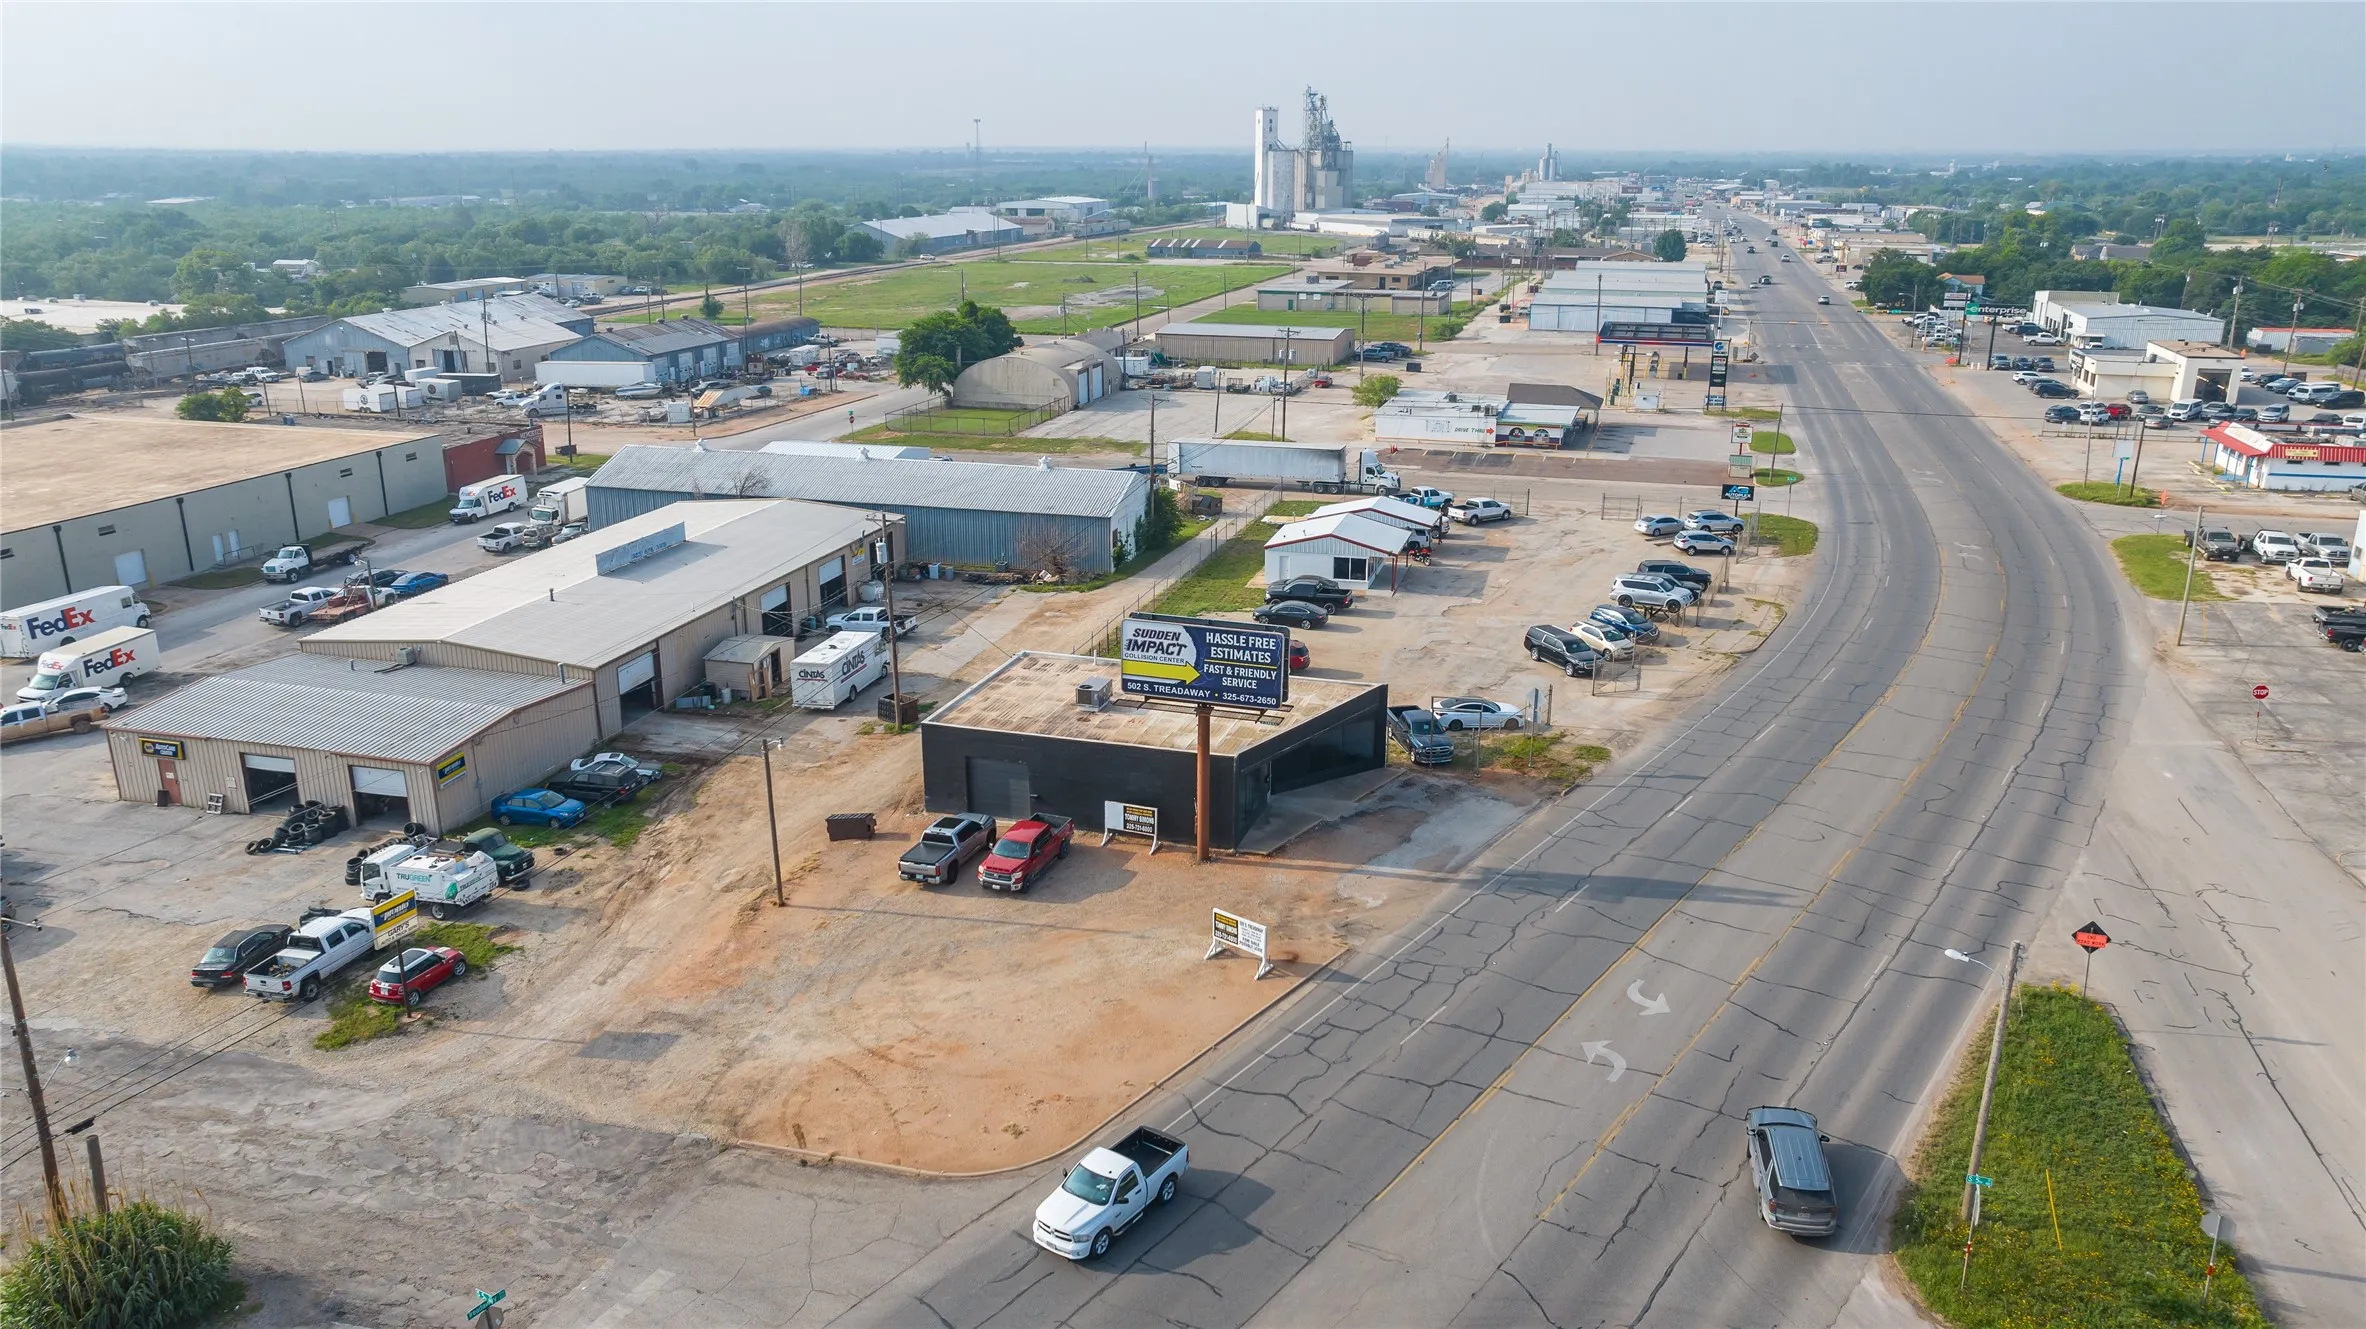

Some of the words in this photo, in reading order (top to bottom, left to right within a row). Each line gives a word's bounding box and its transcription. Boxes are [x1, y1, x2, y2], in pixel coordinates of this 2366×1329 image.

[1970, 305, 2027, 315] enterprise
[487, 484, 517, 504] FedEx
[0, 623, 17, 631] FedEx
[26, 606, 96, 640] FedEx
[1132, 627, 1181, 642] SUDDEN
[1206, 632, 1245, 647] HASSLE
[1248, 638, 1276, 650] FREE
[1126, 639, 1187, 656] IMPACT
[1210, 647, 1271, 664] ESTIMATES
[40, 659, 63, 671] FedEx
[83, 647, 137, 678] FedEx
[842, 650, 865, 676] CINTAS
[1124, 652, 1158, 662] COLLISION
[1159, 656, 1185, 664] CENTER
[798, 668, 825, 679] CINTAS
[1204, 664, 1225, 674] FAST
[1226, 666, 1233, 675] &
[1234, 667, 1277, 680] FRIENDLY
[1222, 677, 1257, 689] SERVICE
[1127, 682, 1141, 691] 502
[1143, 684, 1152, 692] S.
[1154, 685, 1210, 698] TREADAWAY
[1222, 692, 1277, 705] 325-673-2650
[396, 872, 431, 882] TRUGREEN
[384, 901, 409, 921] pronto
[388, 920, 410, 937] GARY'S
